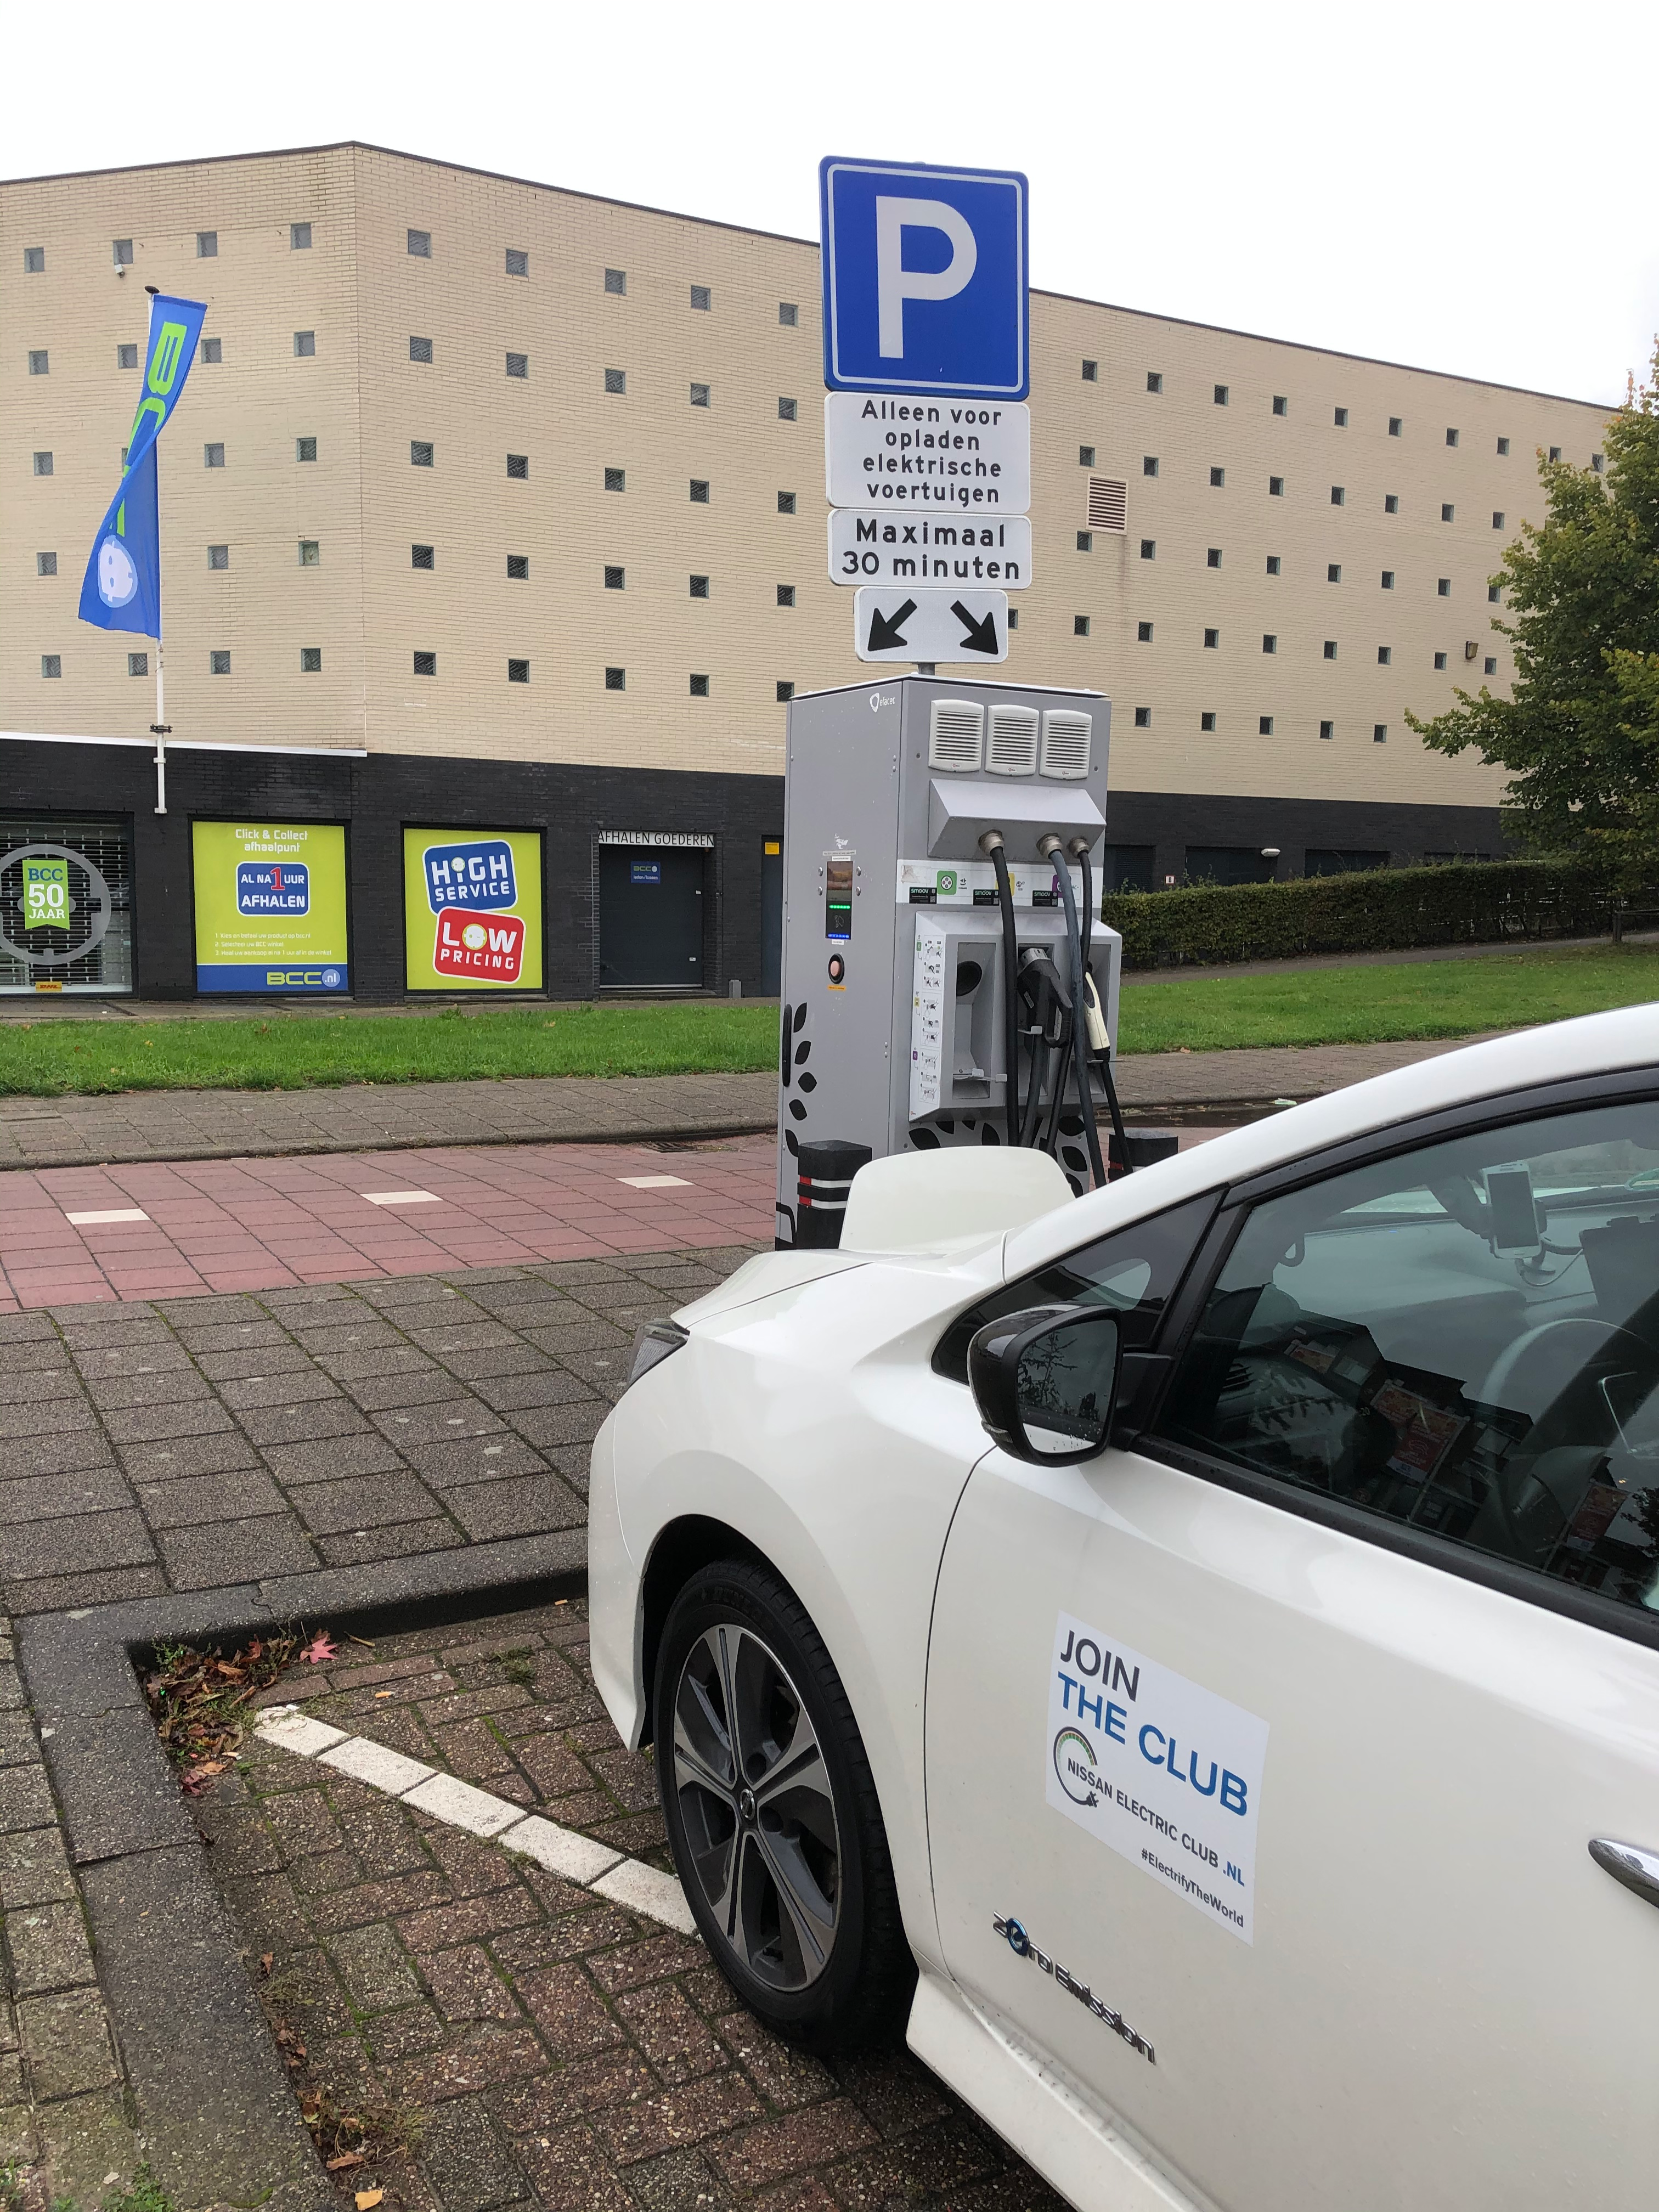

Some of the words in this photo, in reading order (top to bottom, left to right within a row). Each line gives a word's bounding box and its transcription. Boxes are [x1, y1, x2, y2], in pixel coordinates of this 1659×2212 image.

[876, 195, 978, 359] P
[861, 399, 940, 422] Alleen
[950, 408, 1002, 426] voor
[885, 428, 980, 451] opladen
[863, 453, 1002, 478] elektrische
[867, 482, 999, 508] voertuigen
[856, 518, 1005, 548] Maximaal
[842, 551, 879, 575] 30
[893, 554, 1019, 579] minuten
[879, 696, 895, 706] efacec
[235, 829, 259, 839] Click
[262, 830, 270, 839] &
[274, 830, 308, 840] Collect
[599, 830, 650, 844] AFHALEN
[654, 833, 714, 846] GOEDEREN
[244, 842, 300, 854] afhaalpunt
[27, 868, 63, 881] BCC
[241, 874, 255, 883] AL
[257, 874, 272, 883] NA
[270, 867, 285, 890] 1
[284, 874, 304, 884] UUR
[29, 884, 64, 907] 50
[241, 895, 305, 907] AFHALEN
[435, 881, 510, 902] SERVICE
[29, 909, 65, 919] JAAR
[440, 948, 514, 970] PRICING
[1060, 1629, 1141, 1702] JOIN
[1058, 1671, 1128, 1745] THE
[1138, 1724, 1248, 1816] CLUB
[1067, 1757, 1113, 1799] NISSAN
[1116, 1789, 1178, 1842] ELECTRIC
[1181, 1832, 1219, 1868] CLUB
[1222, 1861, 1245, 1887] .NL
[1141, 1847, 1244, 1928] #ElectrifyTheWorld
[1055, 1962, 1156, 2065] Emission
